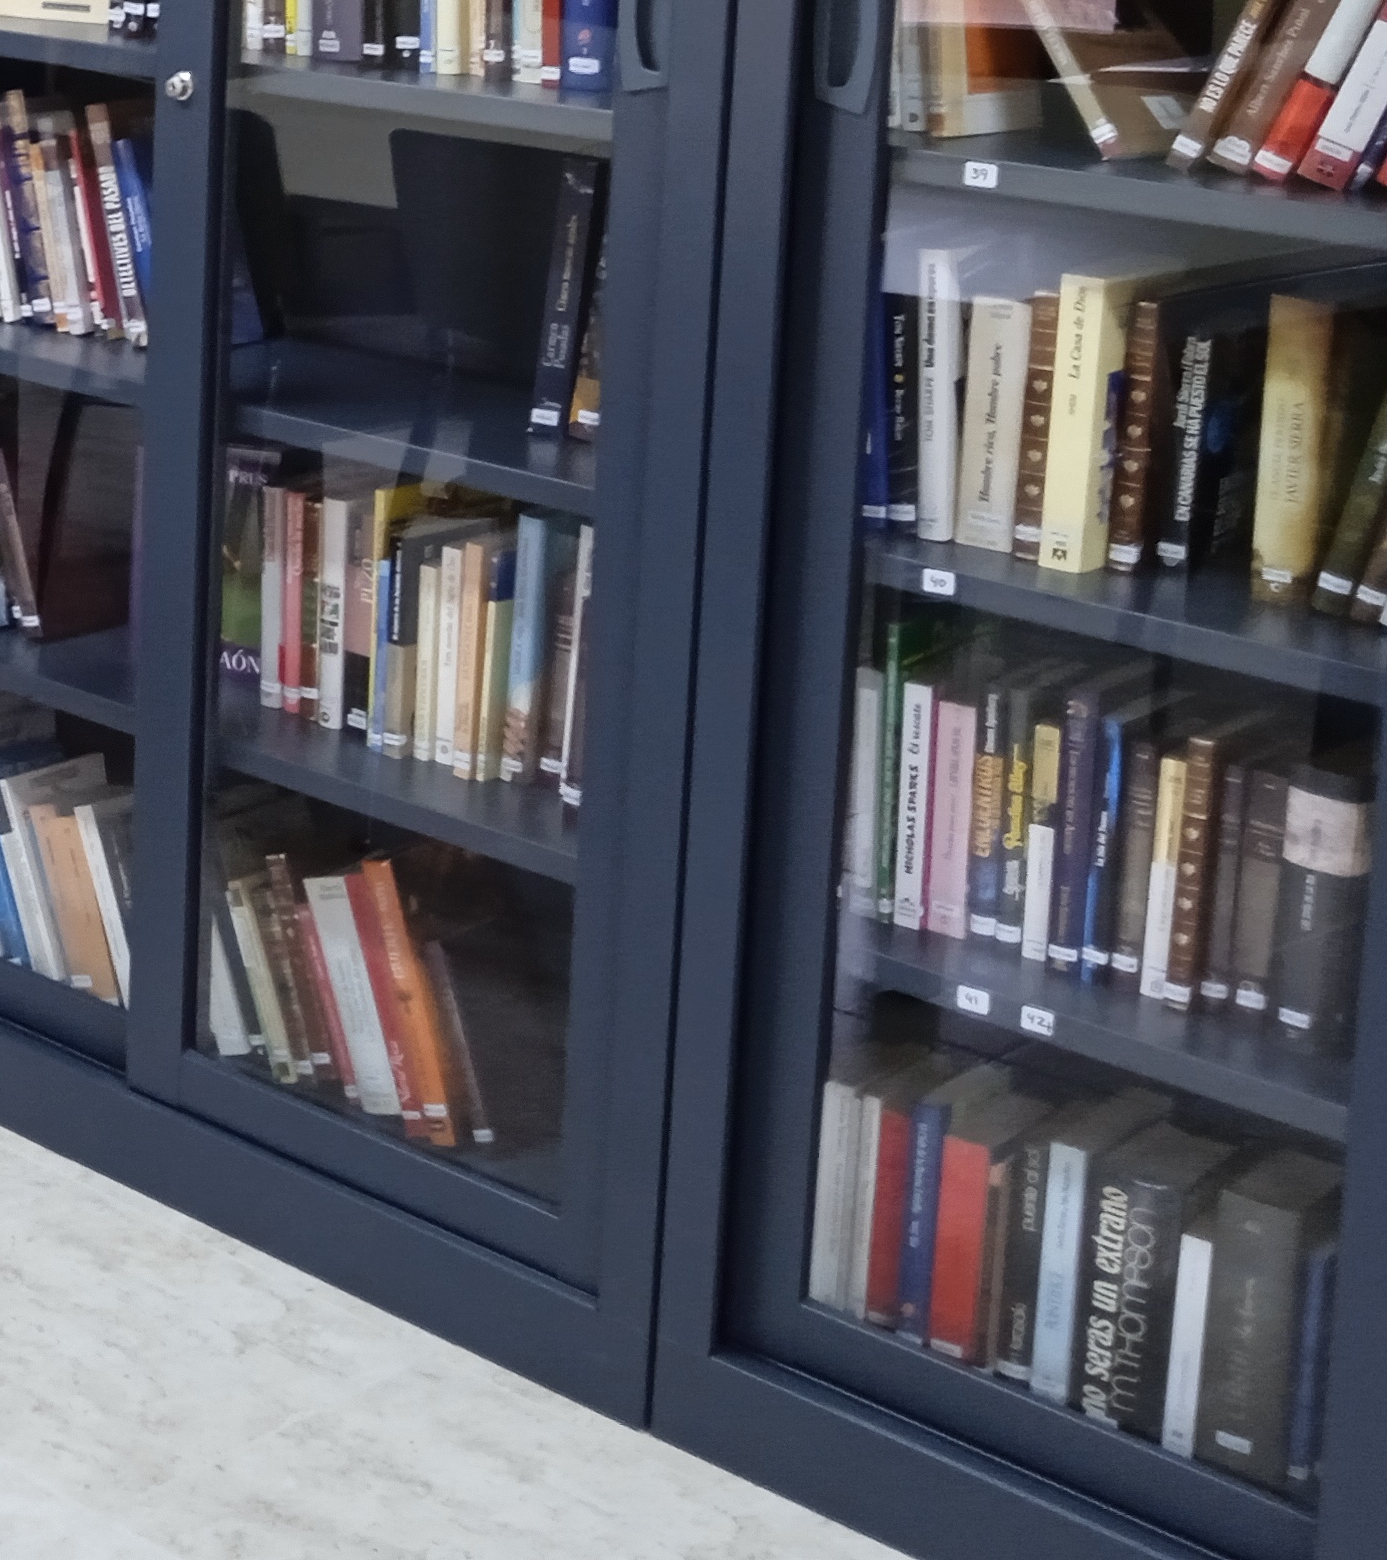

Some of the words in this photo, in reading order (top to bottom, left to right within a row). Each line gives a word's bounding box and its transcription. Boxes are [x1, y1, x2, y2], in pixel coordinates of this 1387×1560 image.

[1227, 18, 1258, 57] PARECE
[1216, 52, 1241, 75] QUE
[1207, 83, 1226, 100] ES
[1212, 72, 1231, 89] LO
[1198, 96, 1218, 113] NO
[971, 167, 989, 182] 39
[107, 211, 126, 232] DEL
[112, 233, 138, 297] DETECTIVES
[1072, 316, 1085, 330] de
[1070, 333, 1083, 361] Casa
[1196, 339, 1211, 361] SOL
[989, 343, 1004, 378] pobre
[1068, 362, 1081, 380] La
[1194, 361, 1209, 376] EL
[985, 379, 1000, 425] Hombre
[1189, 376, 1207, 419] PUESTO
[1187, 418, 1203, 435] HA
[1184, 434, 1201, 451] SE
[977, 458, 993, 503] Hombre
[1177, 450, 1199, 507] CANARIAS
[906, 763, 919, 814] SPARKS
[903, 814, 917, 875] NICHOLAS
[1092, 1279, 1119, 1313] un
